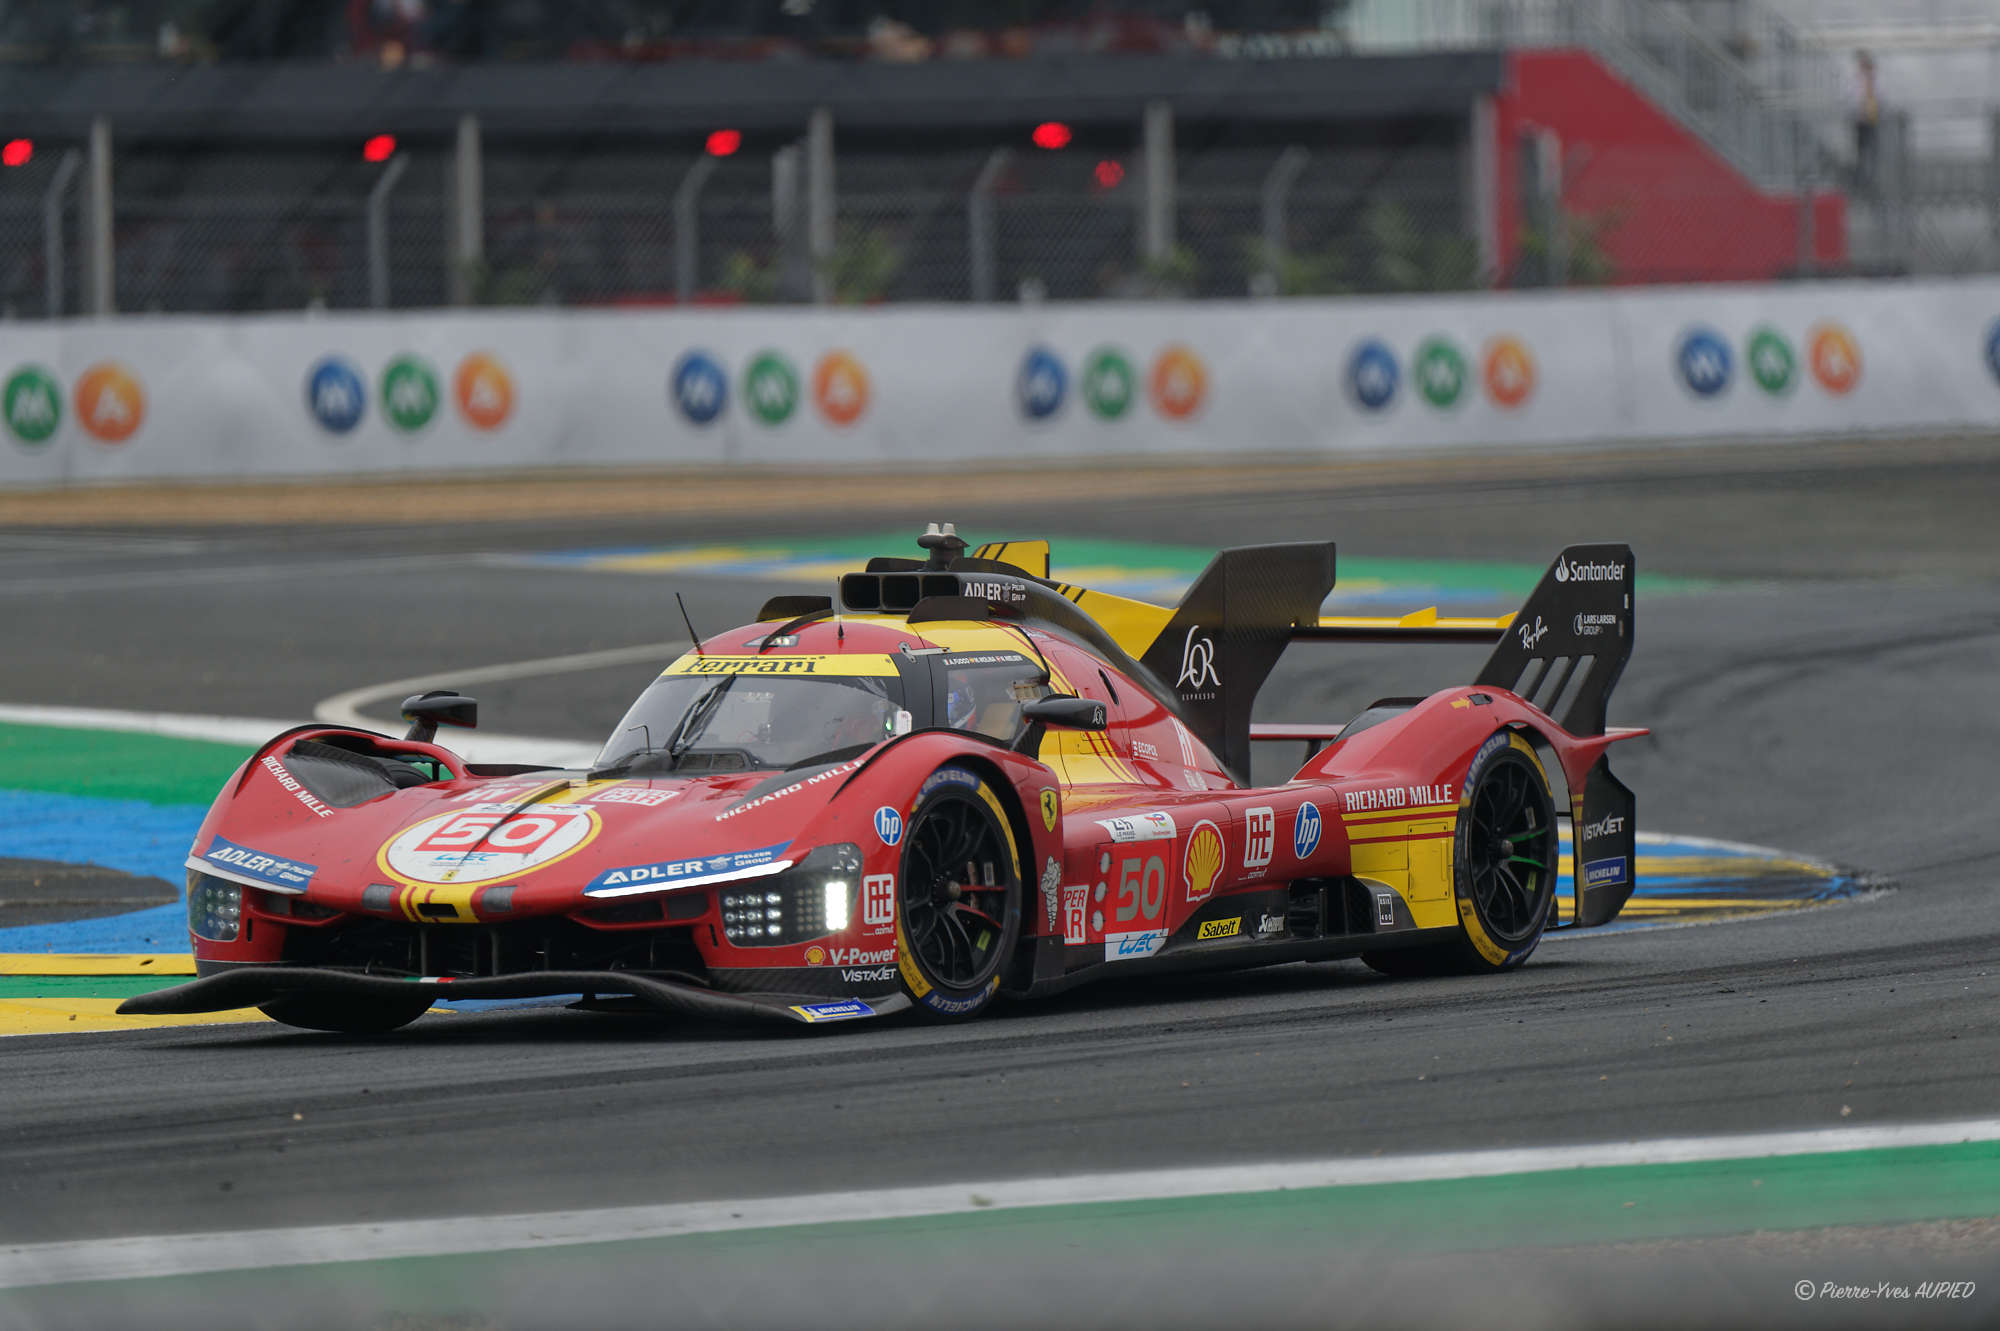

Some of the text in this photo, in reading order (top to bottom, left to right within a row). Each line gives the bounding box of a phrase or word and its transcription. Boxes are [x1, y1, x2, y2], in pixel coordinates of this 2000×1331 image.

[1570, 560, 1625, 582] Santander
[964, 582, 1001, 601] ADLER
[680, 655, 826, 673] Ferrari
[261, 755, 335, 818] RICHARD MILLE
[922, 769, 976, 793] MICHELIN
[715, 783, 803, 822] RICHARD
[1345, 783, 1453, 812] RICHARD MILLE
[427, 816, 557, 847] 50
[880, 814, 899, 844] hp
[1298, 814, 1319, 852] hp
[207, 847, 272, 873] ADLER
[602, 860, 704, 886] ADLER
[1588, 866, 1621, 881] MICHELIN
[1064, 888, 1086, 908] PER
[1116, 855, 1166, 922] 50
[829, 947, 896, 965] V-Power
[1118, 932, 1158, 955] WEC
